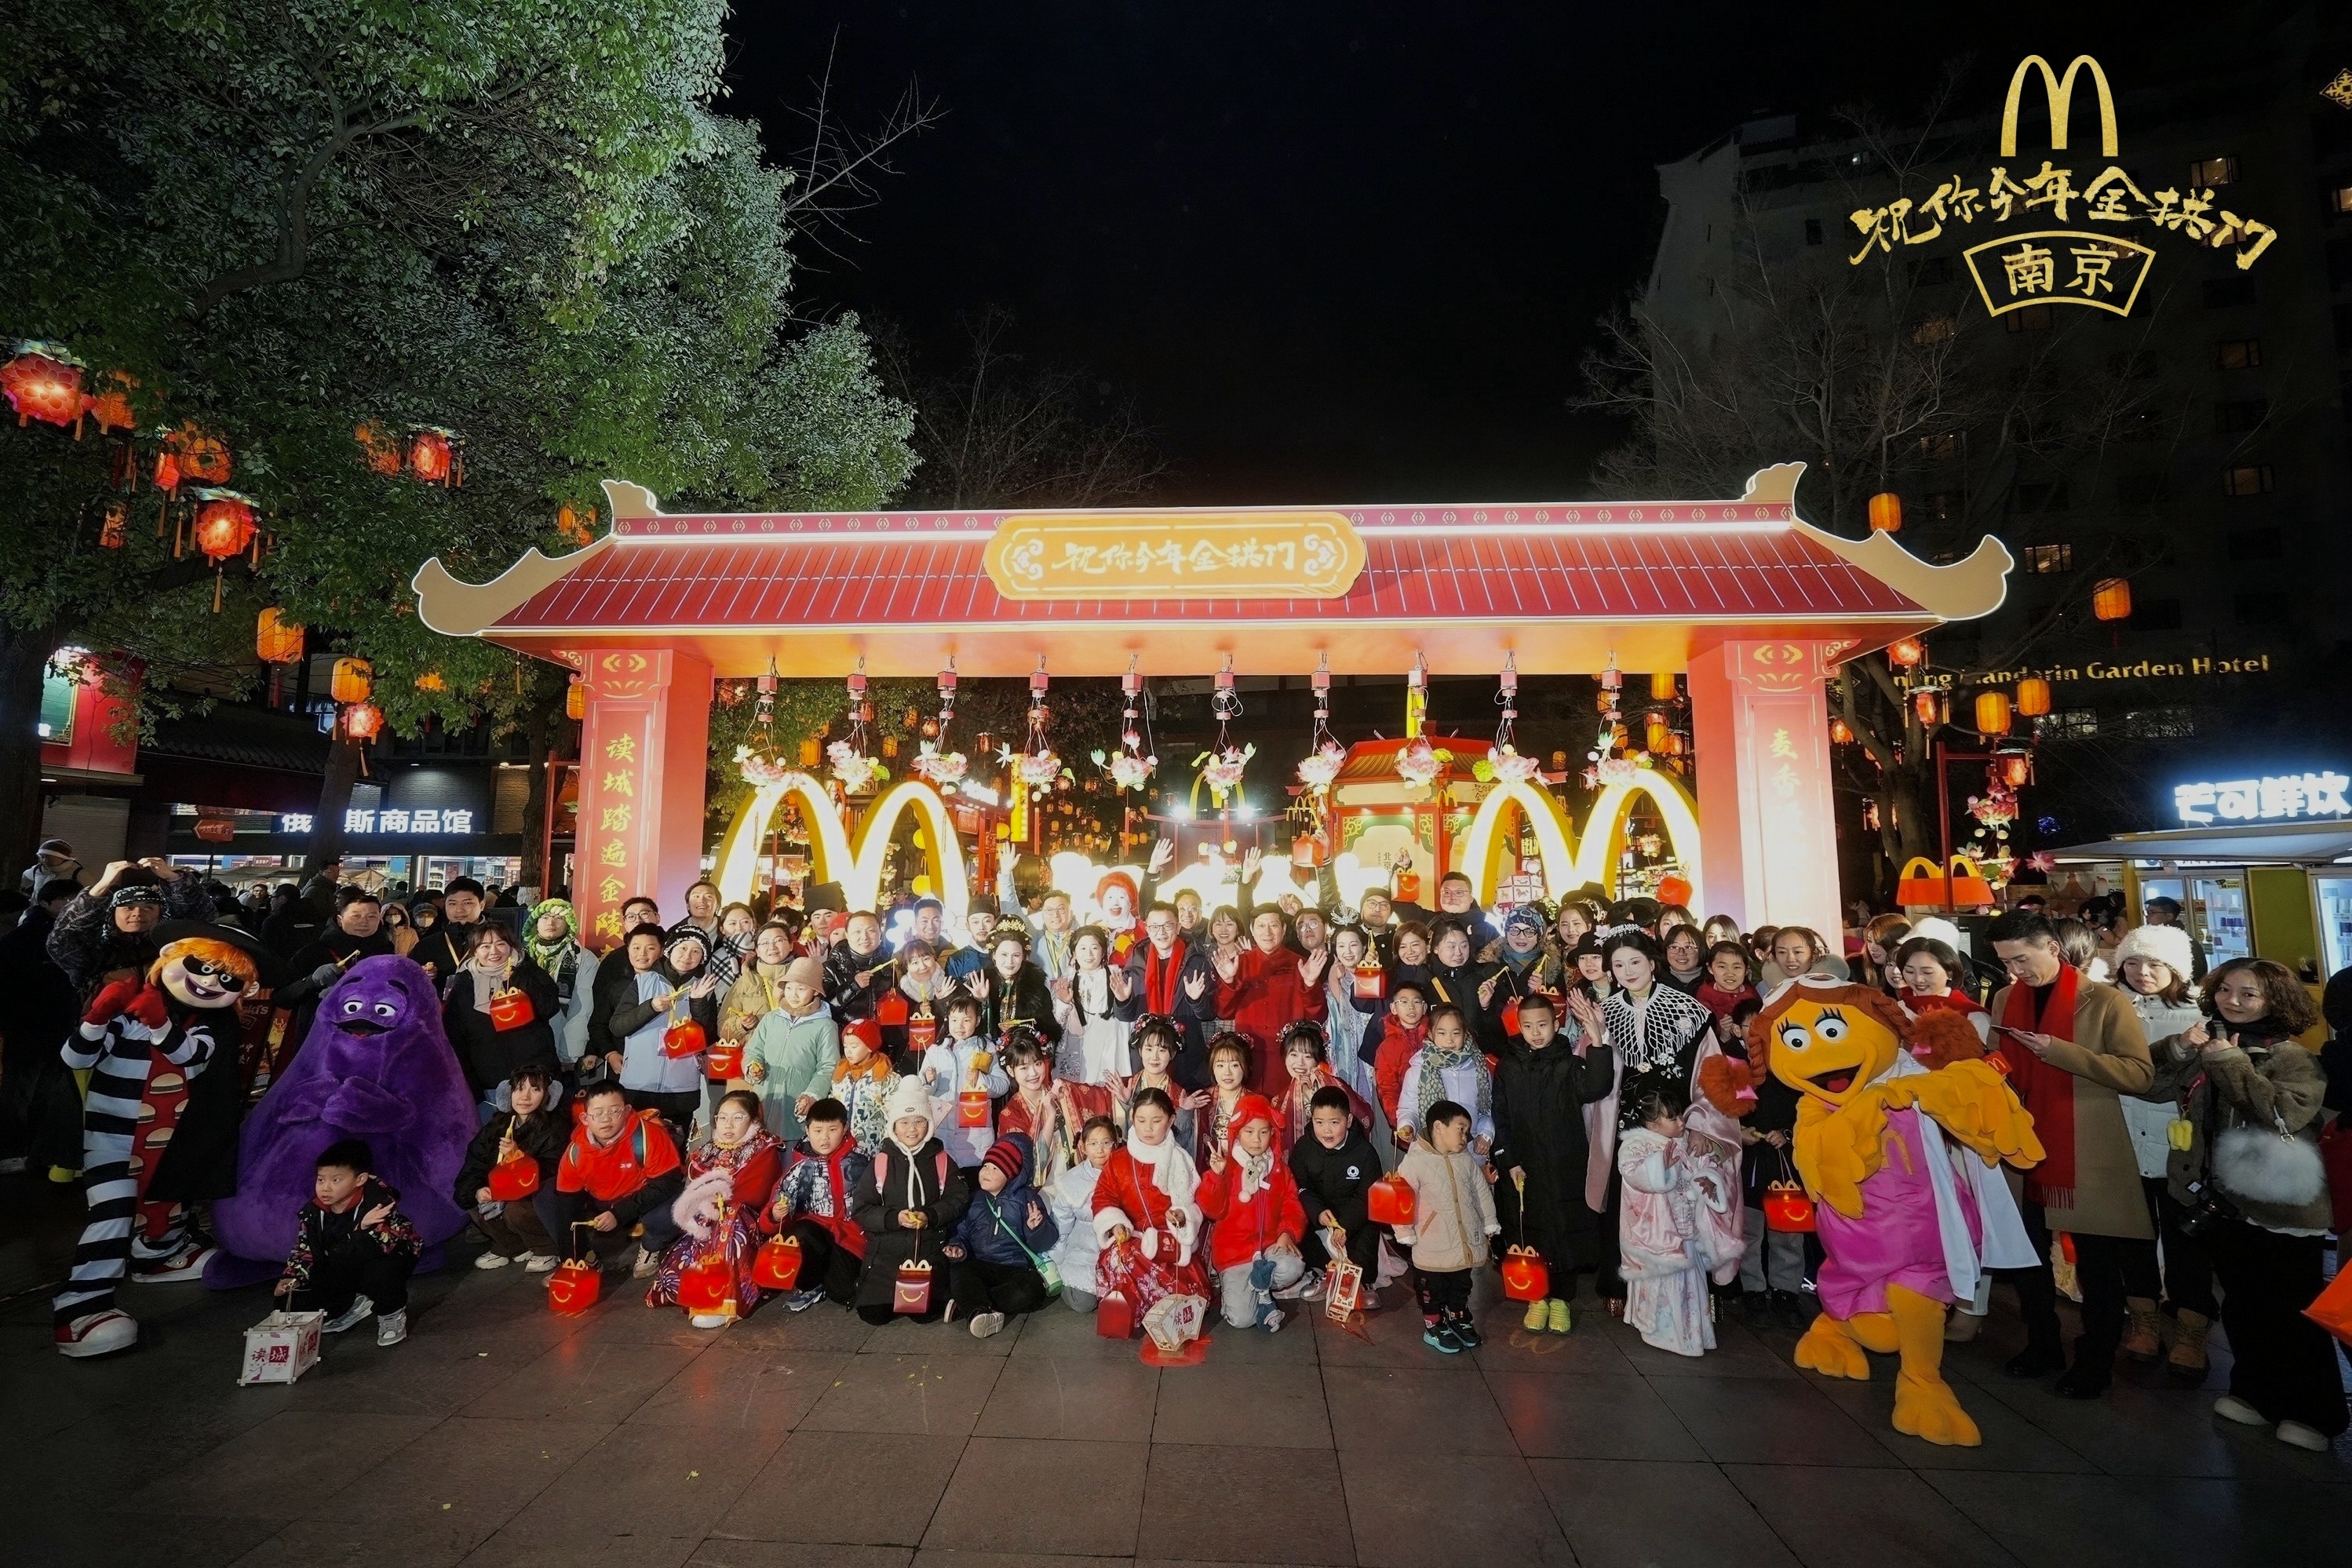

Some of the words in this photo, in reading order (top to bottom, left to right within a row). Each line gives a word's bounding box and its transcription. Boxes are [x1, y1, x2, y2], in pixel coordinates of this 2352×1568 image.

[1052, 538, 1296, 574] 祝你今年金拱门
[2087, 661, 2184, 680] Garden
[2191, 655, 2269, 674] Hotel
[281, 808, 472, 834] 俄斯商品馆
[250, 1344, 290, 1363] 读城
